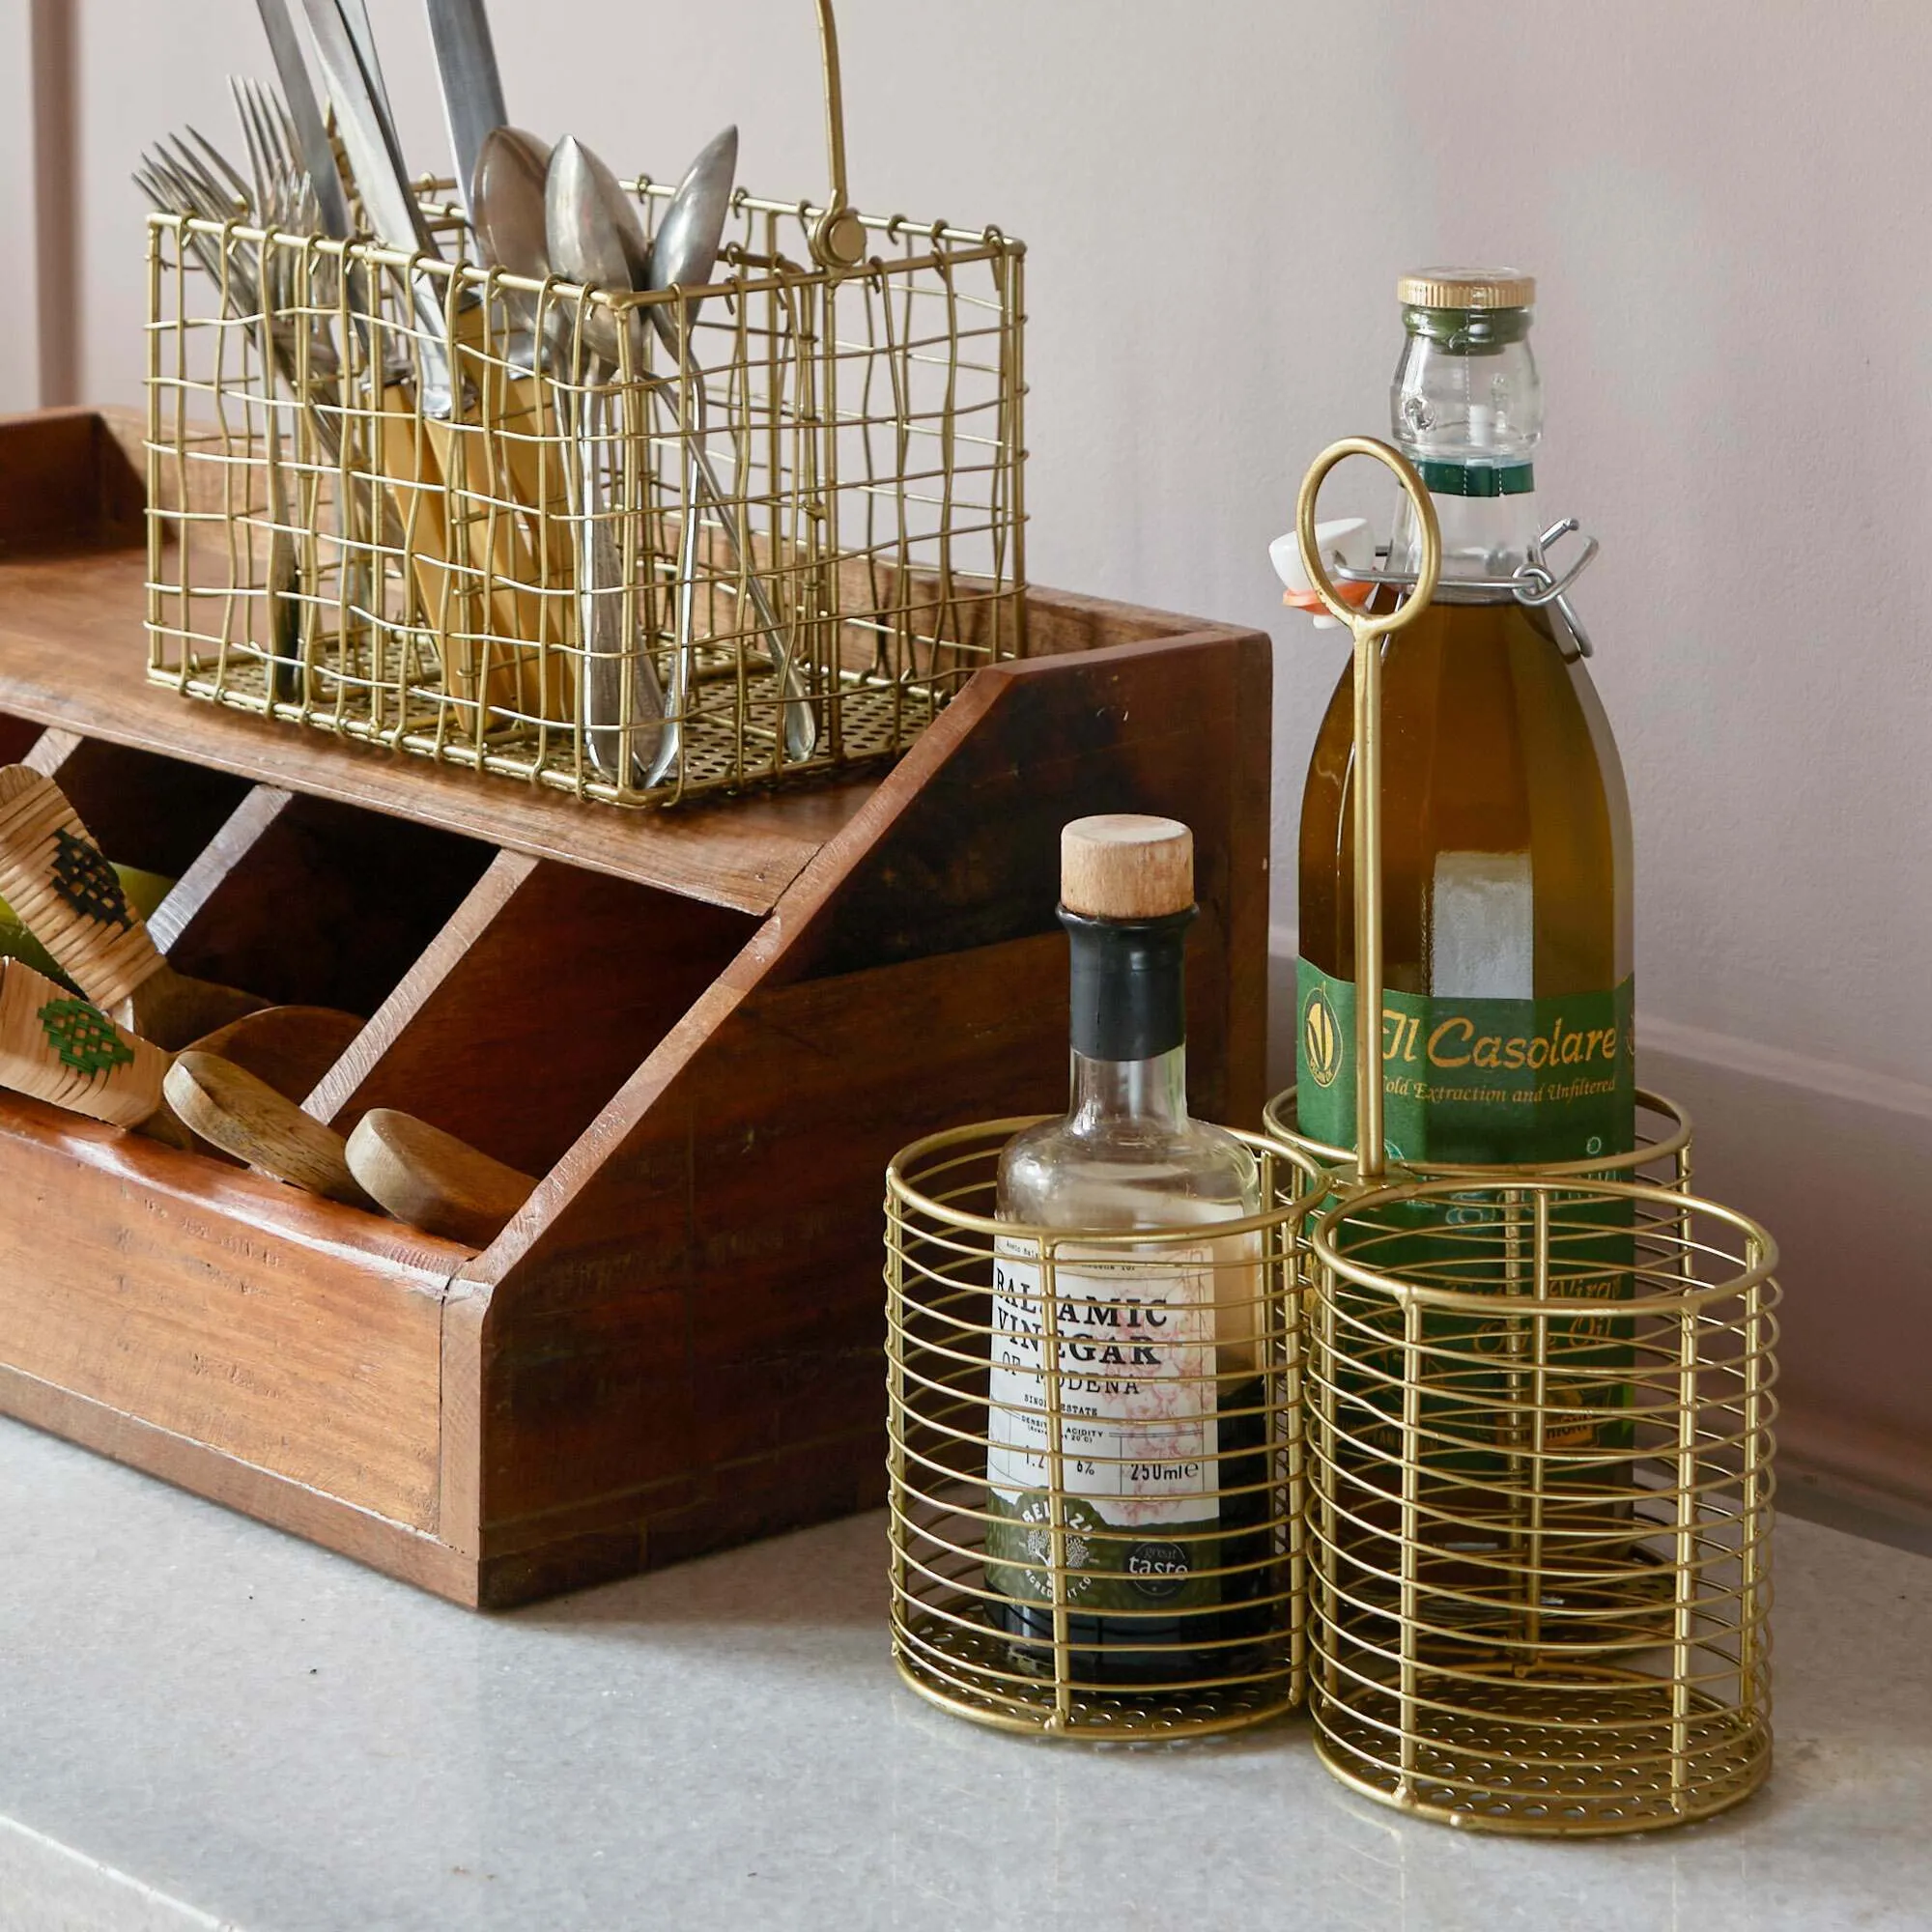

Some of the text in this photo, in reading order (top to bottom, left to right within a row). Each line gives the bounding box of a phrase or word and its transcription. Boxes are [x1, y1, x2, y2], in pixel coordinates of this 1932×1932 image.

[1427, 1016, 1618, 1069] Casolare
[1382, 1074, 1616, 1104] old Extraction and Unfiltered
[996, 1266, 1167, 1327] BALAMIC
[1003, 1350, 1140, 1395] OF MDENA
[1024, 1394, 1047, 1407] SING
[1065, 1427, 1104, 1438] ACIDITY
[1128, 1555, 1189, 1581] taste
